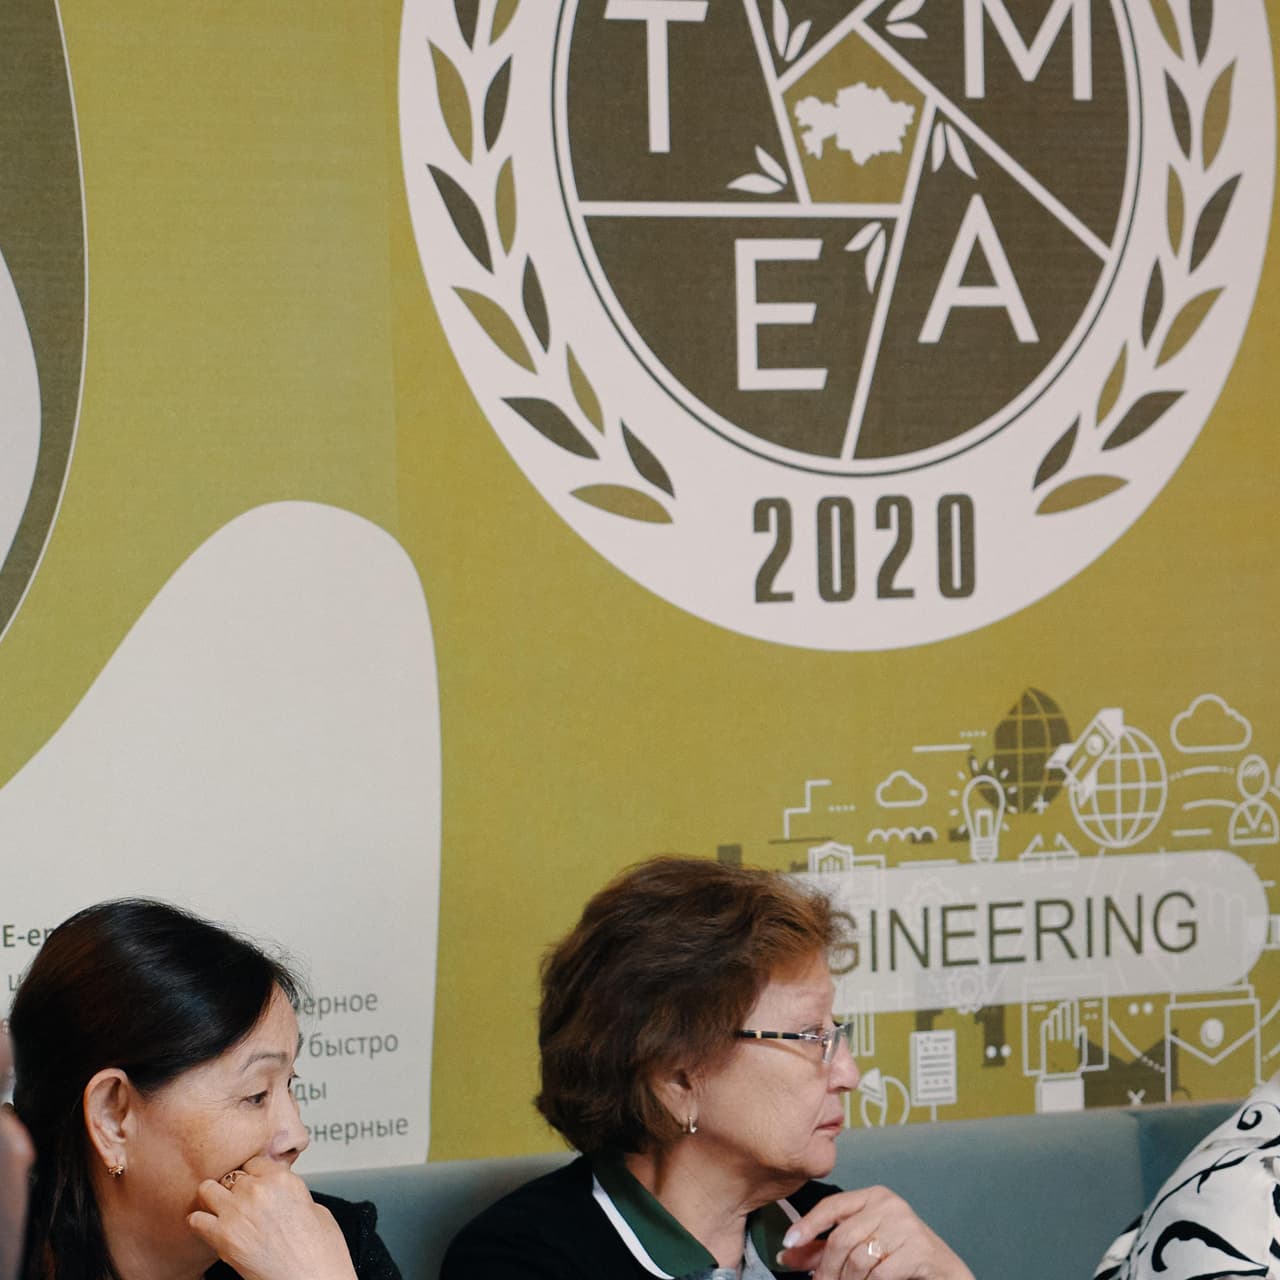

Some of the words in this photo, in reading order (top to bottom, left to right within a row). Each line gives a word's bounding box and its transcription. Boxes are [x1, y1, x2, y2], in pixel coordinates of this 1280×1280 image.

[603, 0, 708, 153] T
[964, 0, 1093, 101] M
[734, 237, 829, 391] E
[918, 193, 1041, 344] A
[751, 492, 978, 605] 2020
[828, 889, 1200, 977] GINEERING
[297, 992, 380, 1020] ерное
[308, 1031, 400, 1060] быстро
[305, 1116, 410, 1147] нерные
